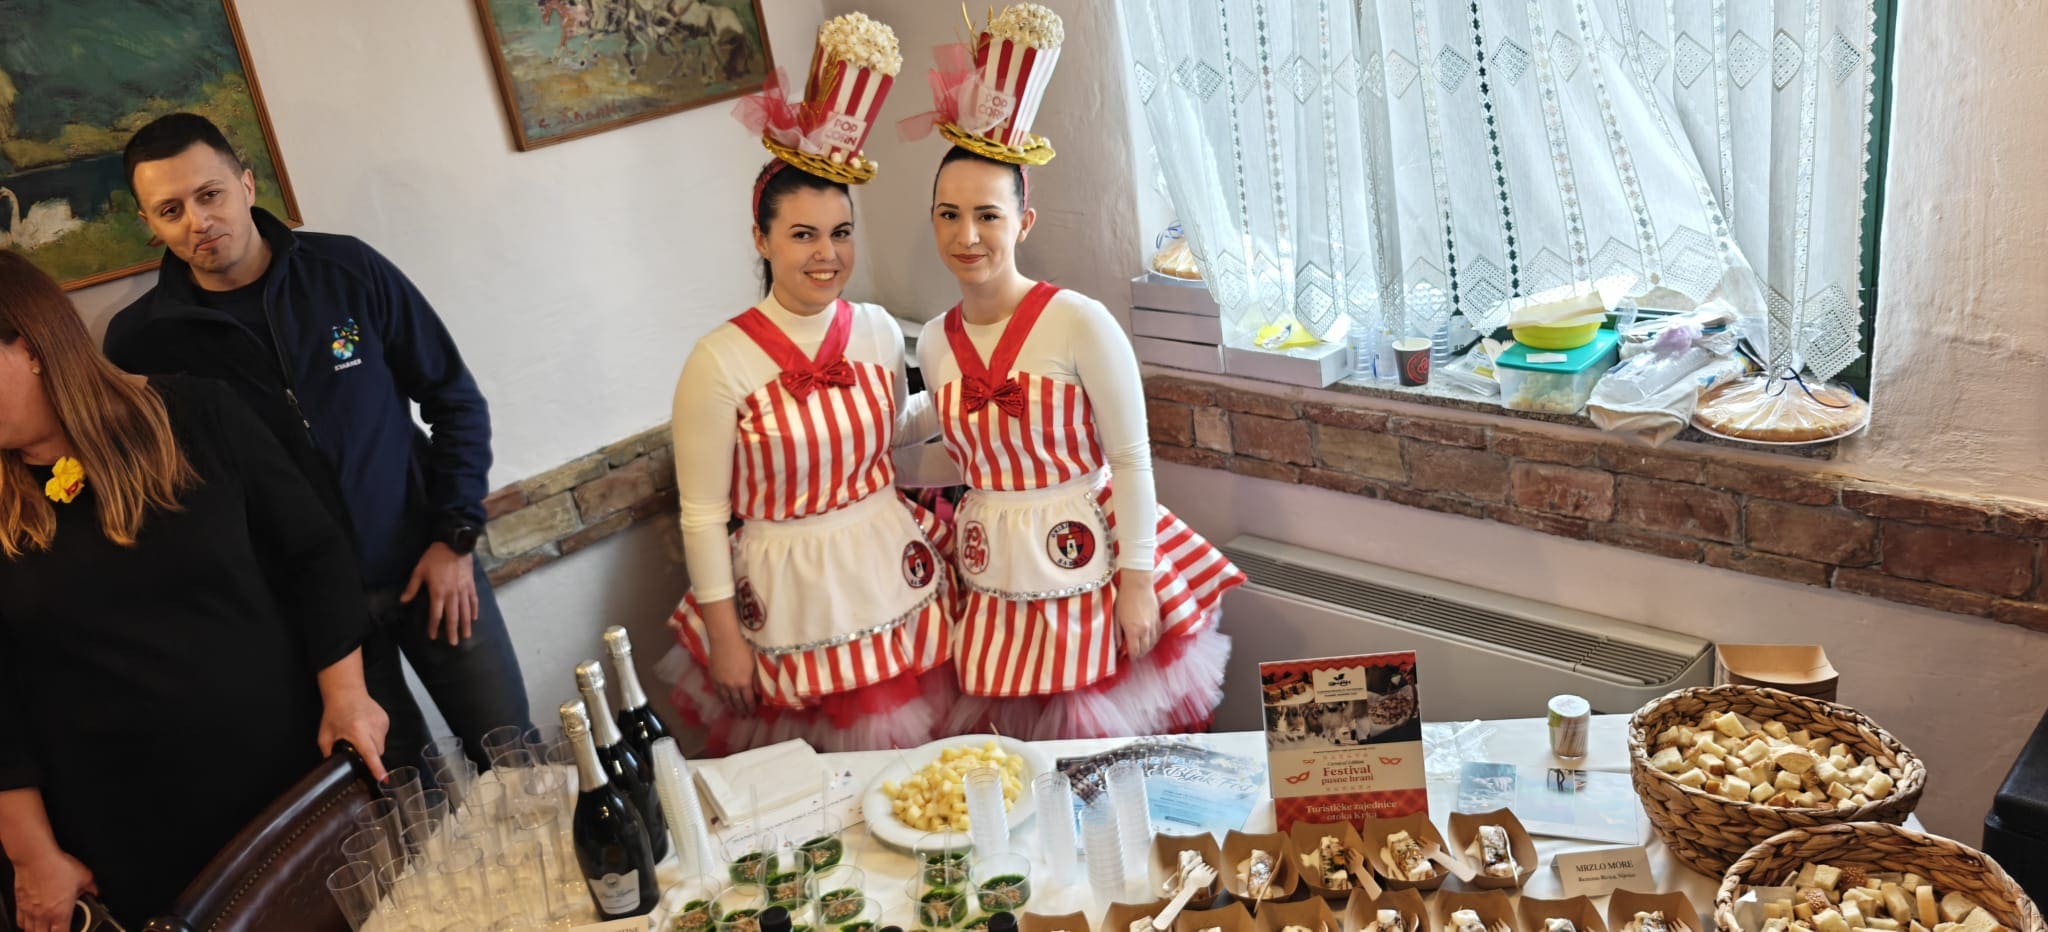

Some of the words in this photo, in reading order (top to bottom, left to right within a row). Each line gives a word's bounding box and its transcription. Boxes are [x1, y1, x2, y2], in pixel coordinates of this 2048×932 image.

[985, 93, 1010, 108] POP
[835, 117, 859, 133] POP
[825, 127, 858, 146] CORN
[1323, 765, 1371, 777] Festival
[1321, 776, 1347, 785] pusne
[1349, 774, 1374, 783] hrani
[1306, 803, 1352, 814] Turističke
[1353, 800, 1398, 811] zajednice
[1327, 812, 1352, 821] otoka
[1576, 862, 1607, 873] MRZLO
[1607, 860, 1634, 870] MORE
